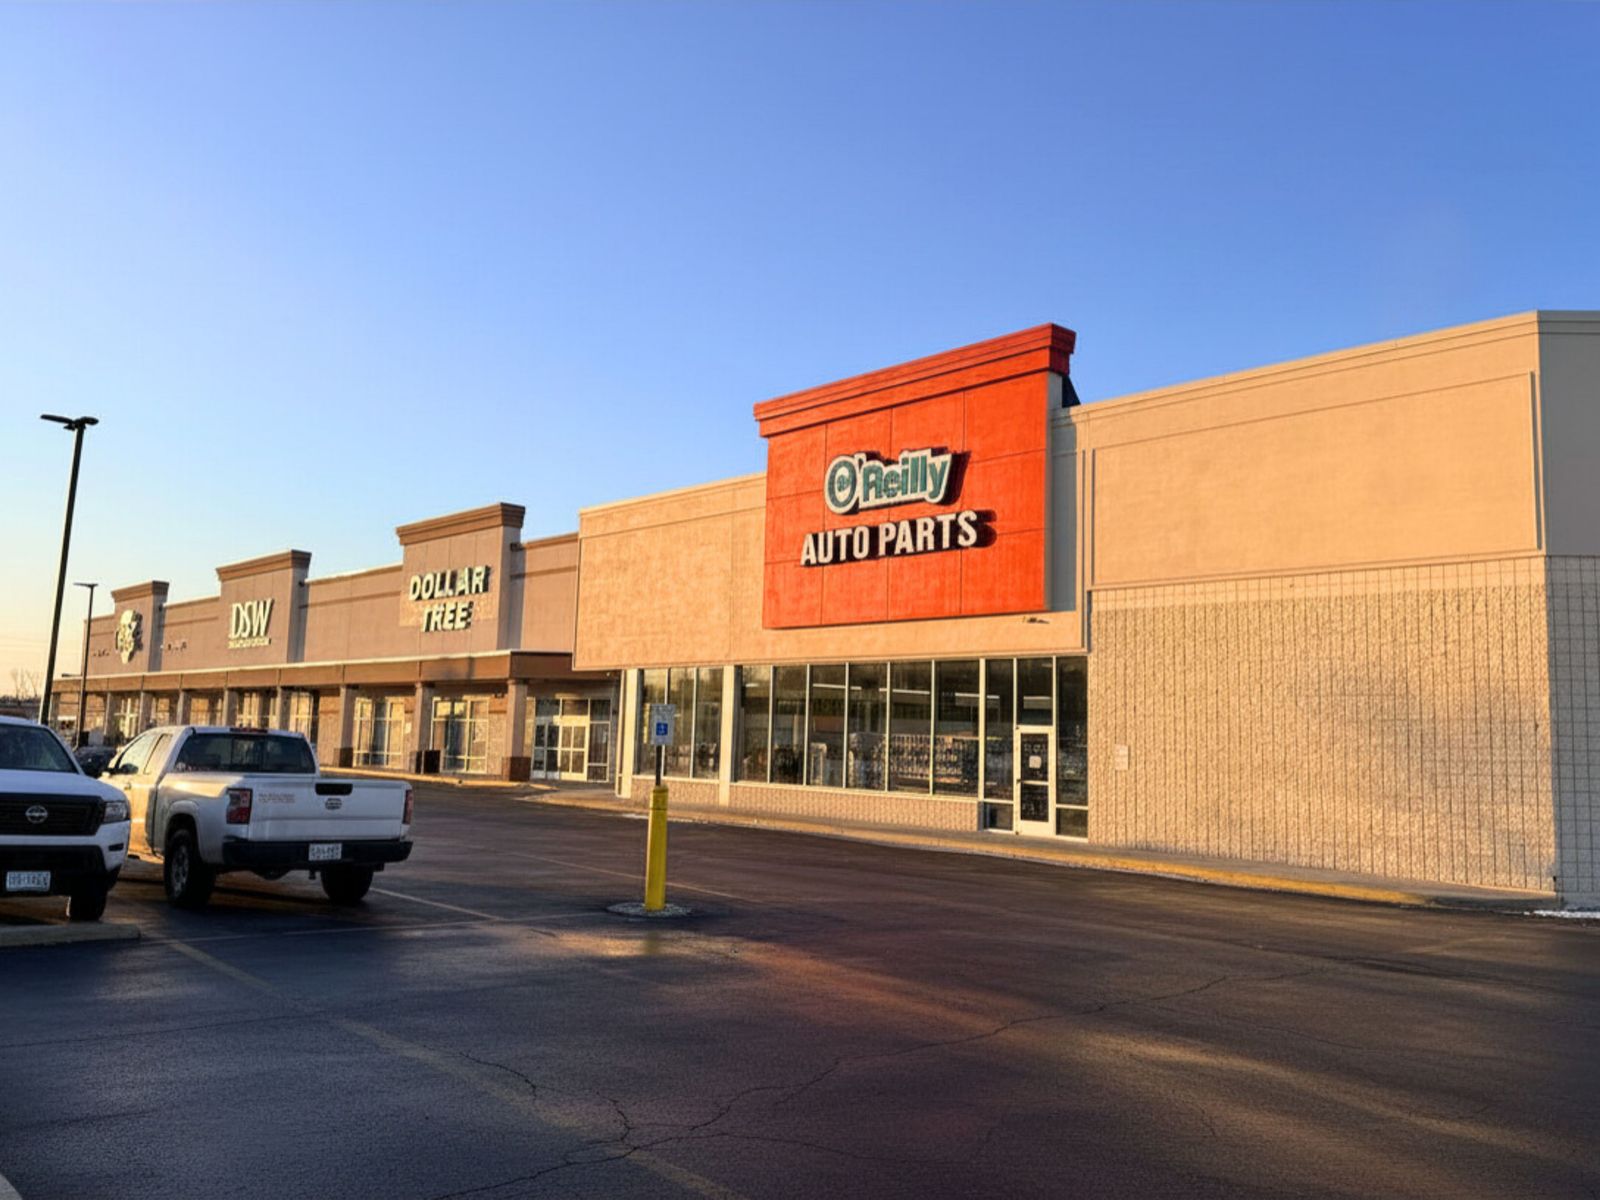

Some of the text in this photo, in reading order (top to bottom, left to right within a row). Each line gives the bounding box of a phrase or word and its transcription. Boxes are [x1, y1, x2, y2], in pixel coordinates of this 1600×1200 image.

[825, 448, 952, 513] O'Reilly
[801, 510, 978, 566] AUTO PARTS
[409, 566, 486, 600] DOLLAR
[229, 598, 272, 638] DSW
